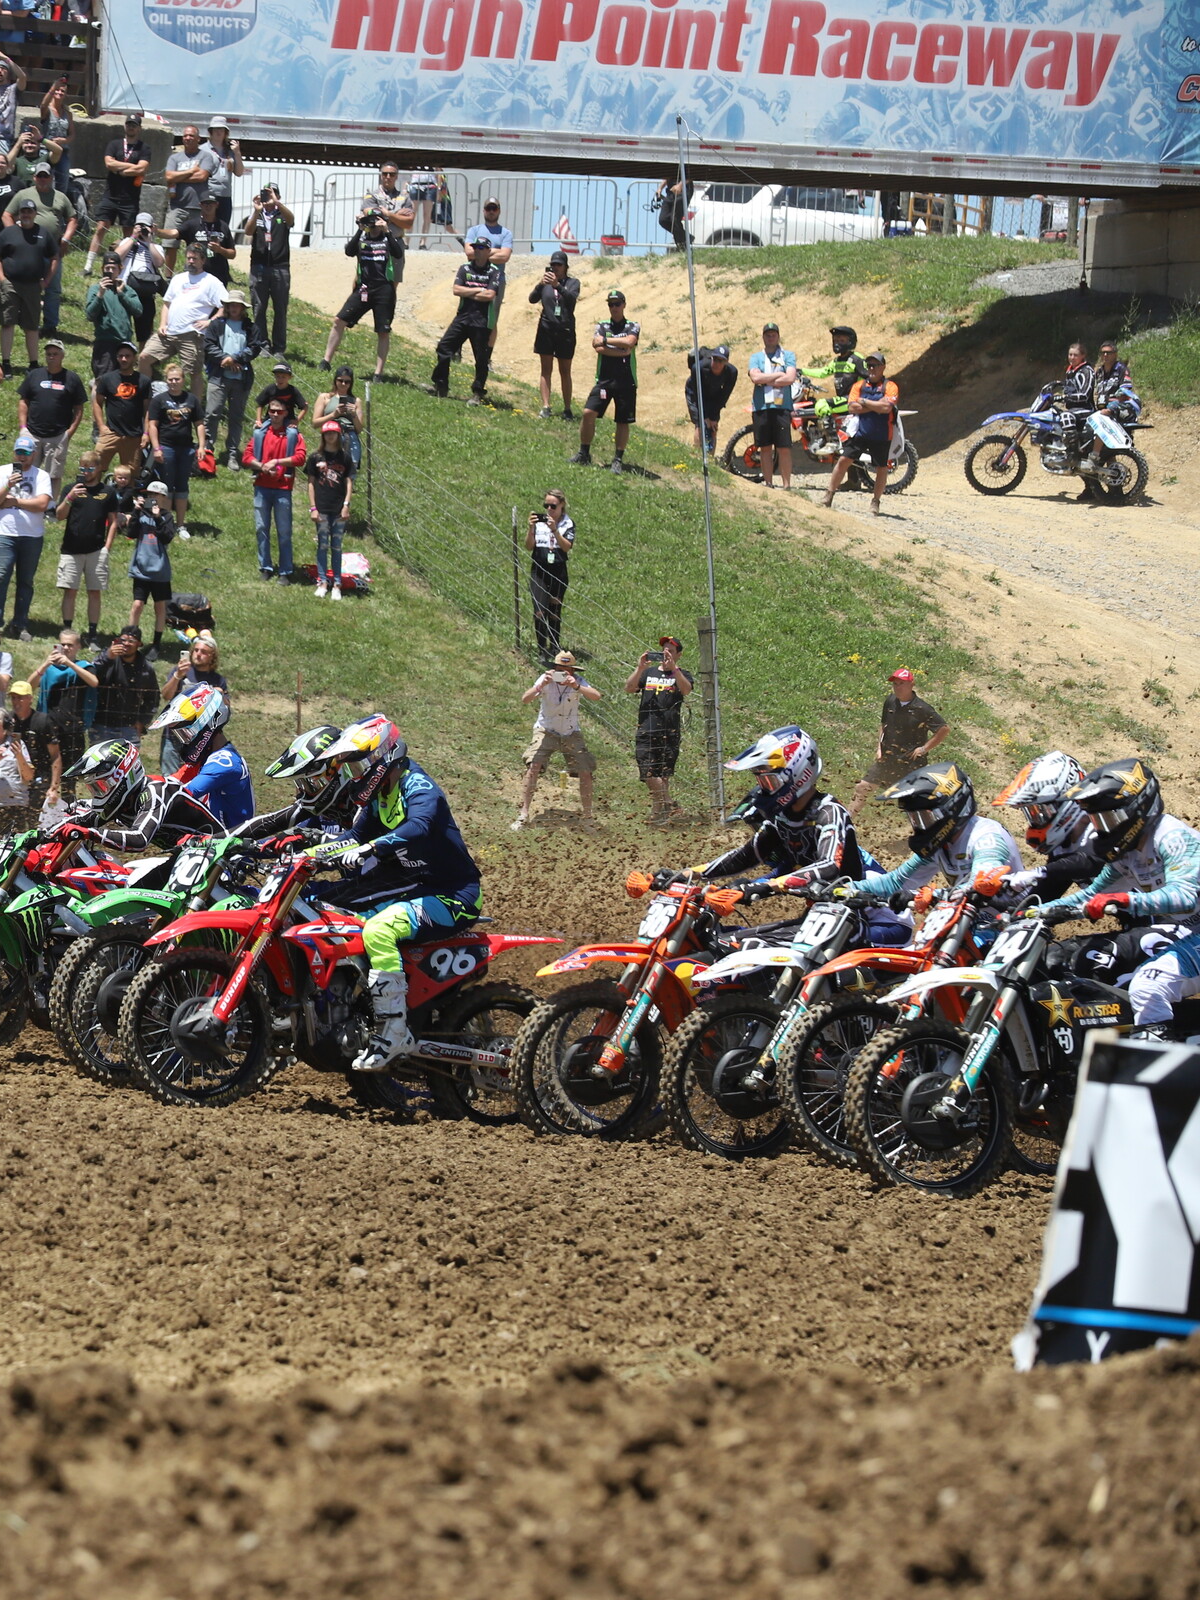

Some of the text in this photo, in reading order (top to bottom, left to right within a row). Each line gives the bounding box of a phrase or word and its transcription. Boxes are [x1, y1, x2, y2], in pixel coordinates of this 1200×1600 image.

[149, 13, 250, 30] OIL PRODUCTS
[186, 32, 215, 45] INC.
[330, 0, 1122, 107] High Point Raceway
[315, 838, 359, 853] HONDA
[170, 854, 210, 887] 30
[638, 902, 678, 939] 36
[793, 911, 837, 946] 50
[429, 947, 477, 977] 96
[985, 930, 1030, 964] 24
[220, 965, 247, 1012] DUNLOP
[625, 1002, 649, 1034] MOTOREX
[476, 1053, 496, 1063] DID
[974, 1031, 999, 1069] MOTOREX
